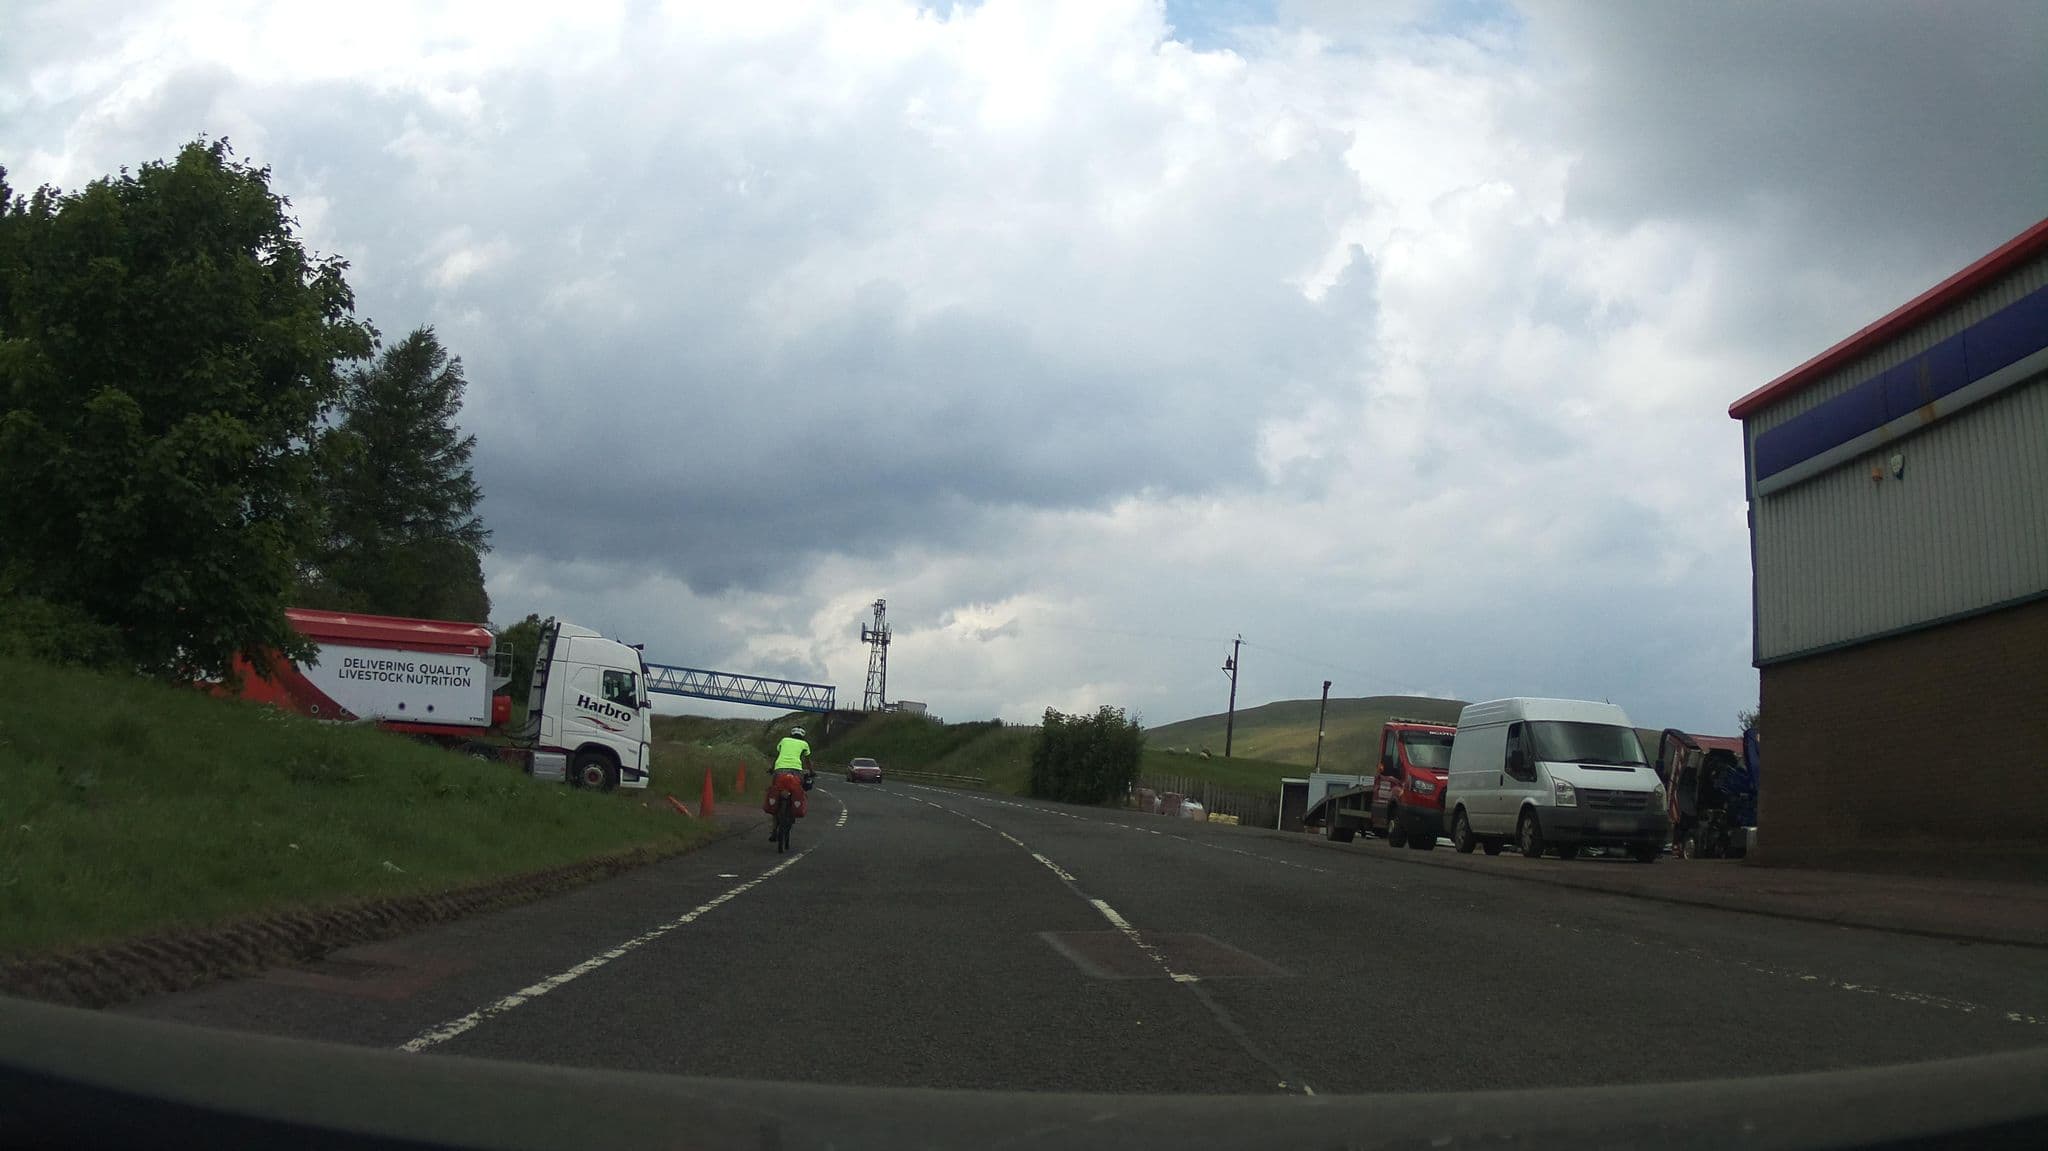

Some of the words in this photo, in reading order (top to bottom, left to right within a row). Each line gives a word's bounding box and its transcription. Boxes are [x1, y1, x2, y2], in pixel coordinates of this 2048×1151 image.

[344, 658, 414, 672] DELIVERING
[419, 663, 471, 676] QUALITY
[339, 669, 403, 683] LIVESTOCK
[407, 674, 471, 687] NUTRITION
[577, 694, 631, 722] Harbro
